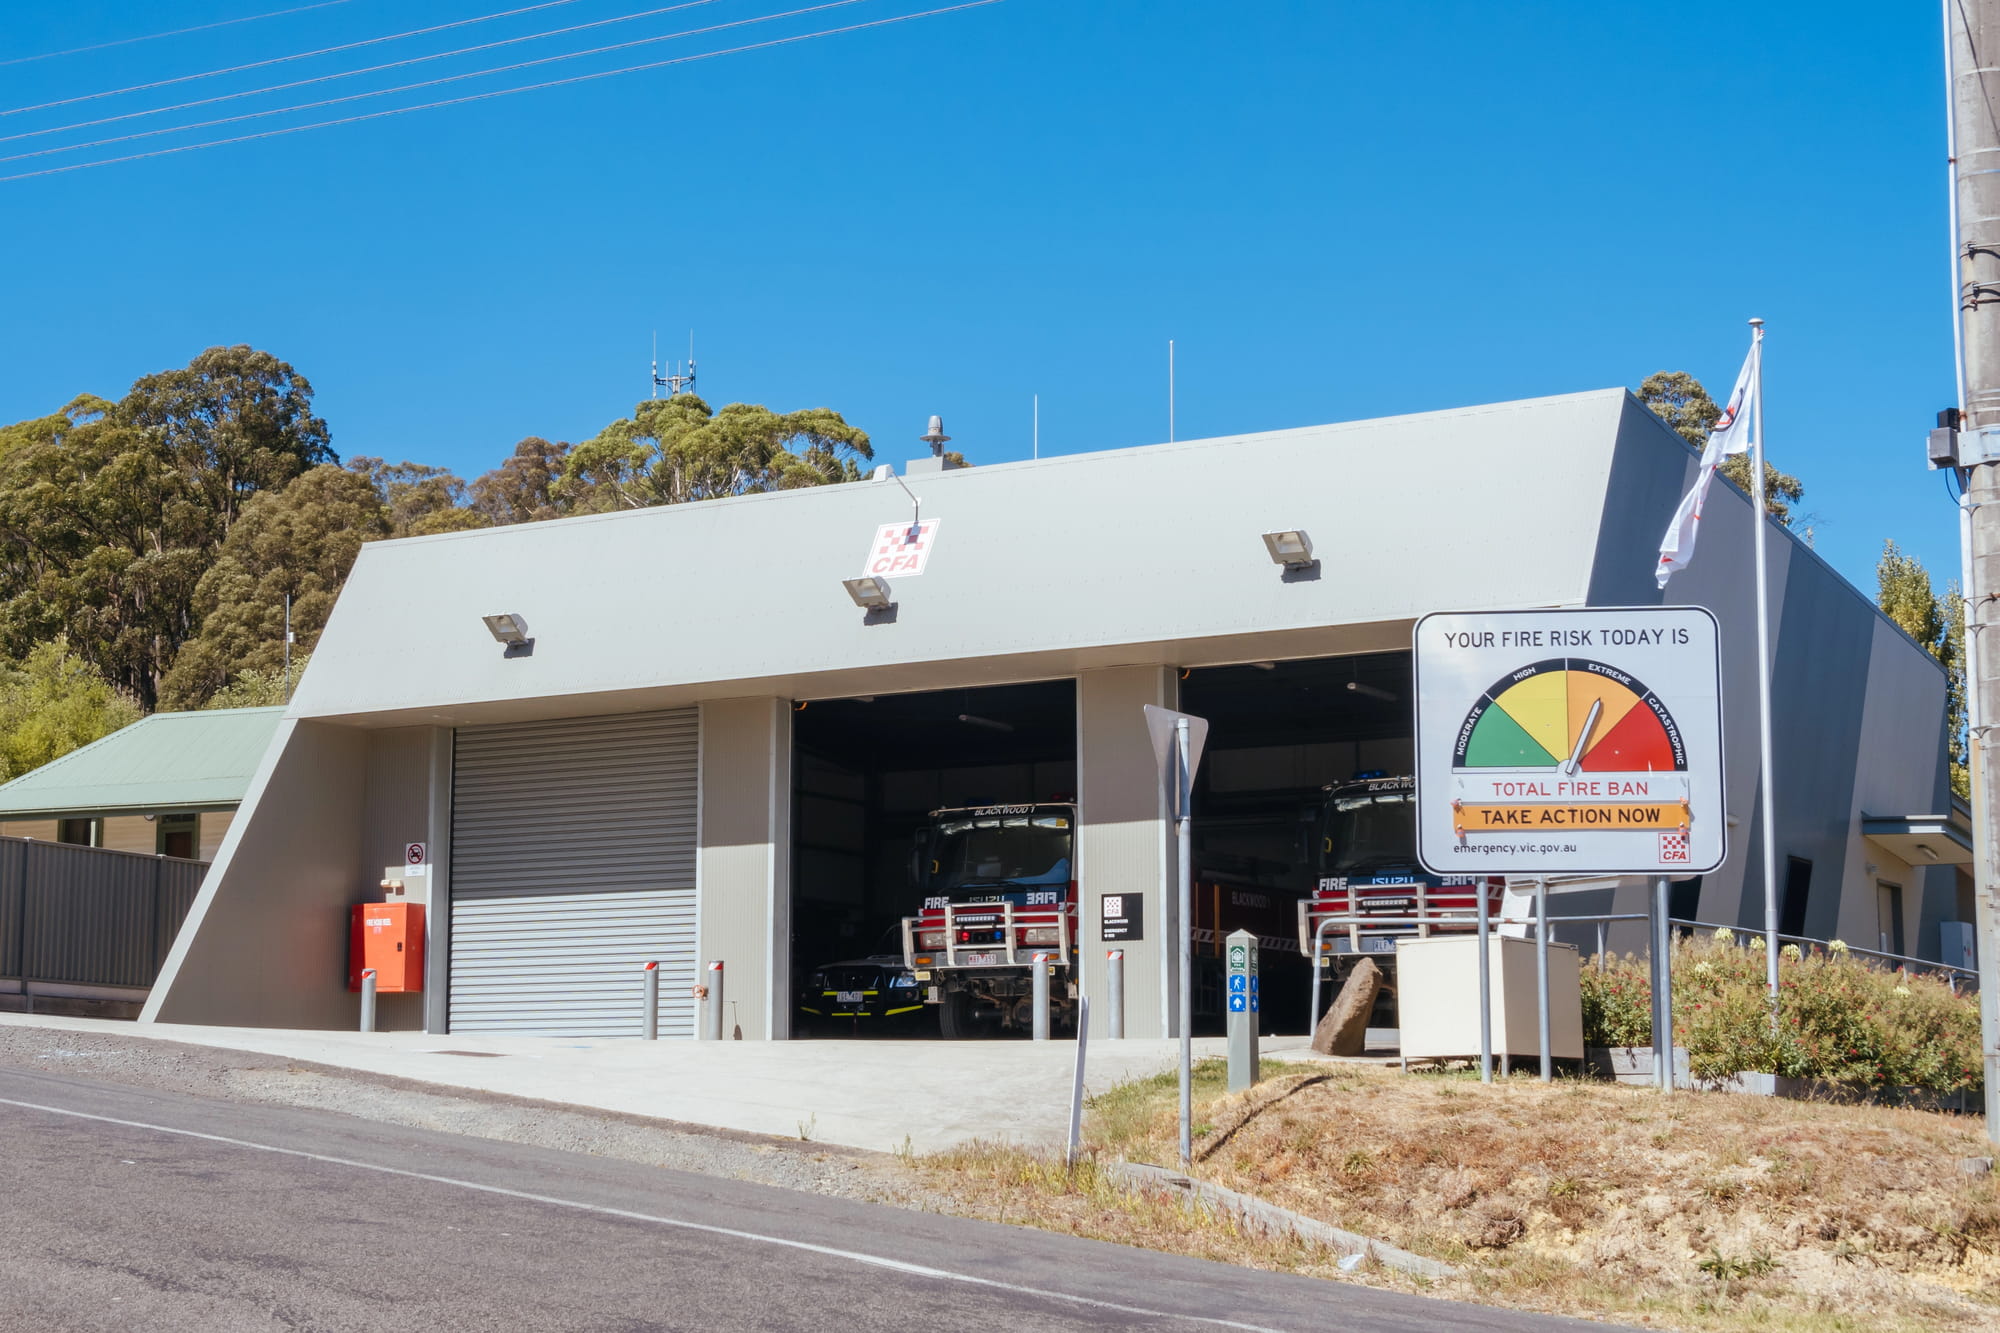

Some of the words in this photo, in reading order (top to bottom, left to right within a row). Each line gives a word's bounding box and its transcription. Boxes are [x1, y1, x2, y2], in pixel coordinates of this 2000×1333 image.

[872, 554, 919, 574] CFA
[1444, 631, 1495, 649] YOUR
[1502, 631, 1543, 647] FIRE
[1550, 630, 1593, 647] RISK
[1600, 629, 1664, 646] TODAY
[1672, 628, 1689, 645] IS
[1512, 666, 1537, 681] HIGH
[1588, 663, 1632, 685] EXTREME
[1456, 706, 1482, 756] MODERATE
[1648, 697, 1685, 765] CATASTROPHIC
[1492, 782, 1551, 797] TOTAL
[1558, 782, 1601, 796] FIRE
[1608, 781, 1648, 796] BAN
[1481, 810, 1532, 825] TAKE
[1540, 809, 1611, 824] ACTION
[1618, 808, 1661, 823] NOW
[1453, 843, 1577, 856] emergency.vic.gov.au
[1663, 851, 1687, 860] CFA
[1319, 877, 1348, 891] FIRE
[1372, 876, 1414, 885] ISUZU
[924, 896, 949, 909] FIRE
